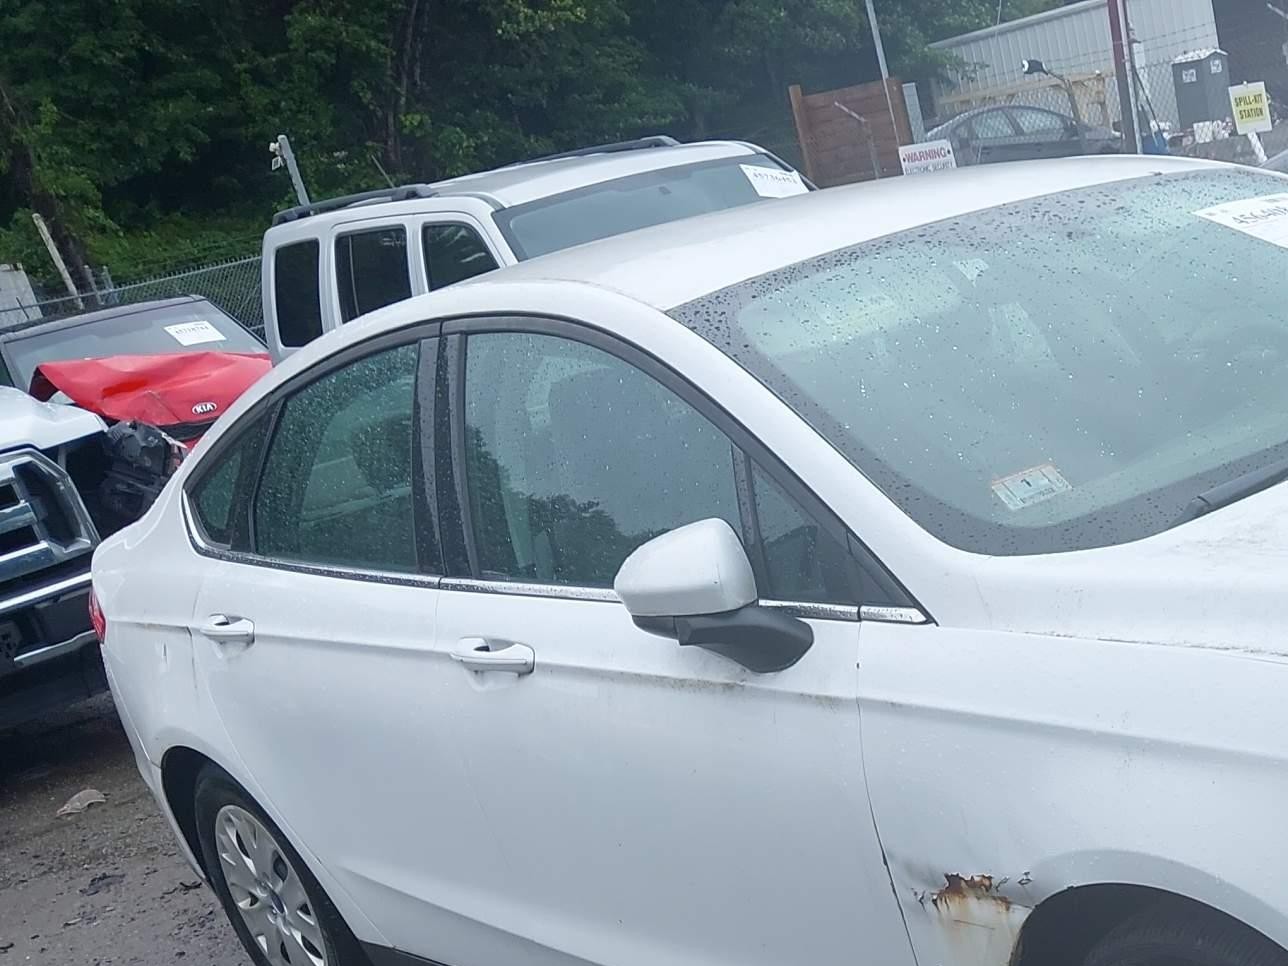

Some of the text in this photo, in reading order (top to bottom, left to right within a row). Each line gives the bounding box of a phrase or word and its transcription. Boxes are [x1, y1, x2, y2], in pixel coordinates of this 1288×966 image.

[1234, 93, 1263, 107] SPILL-KIT
[1239, 107, 1264, 120] STATION
[905, 147, 947, 162] WARNING
[195, 403, 215, 414] KIA
